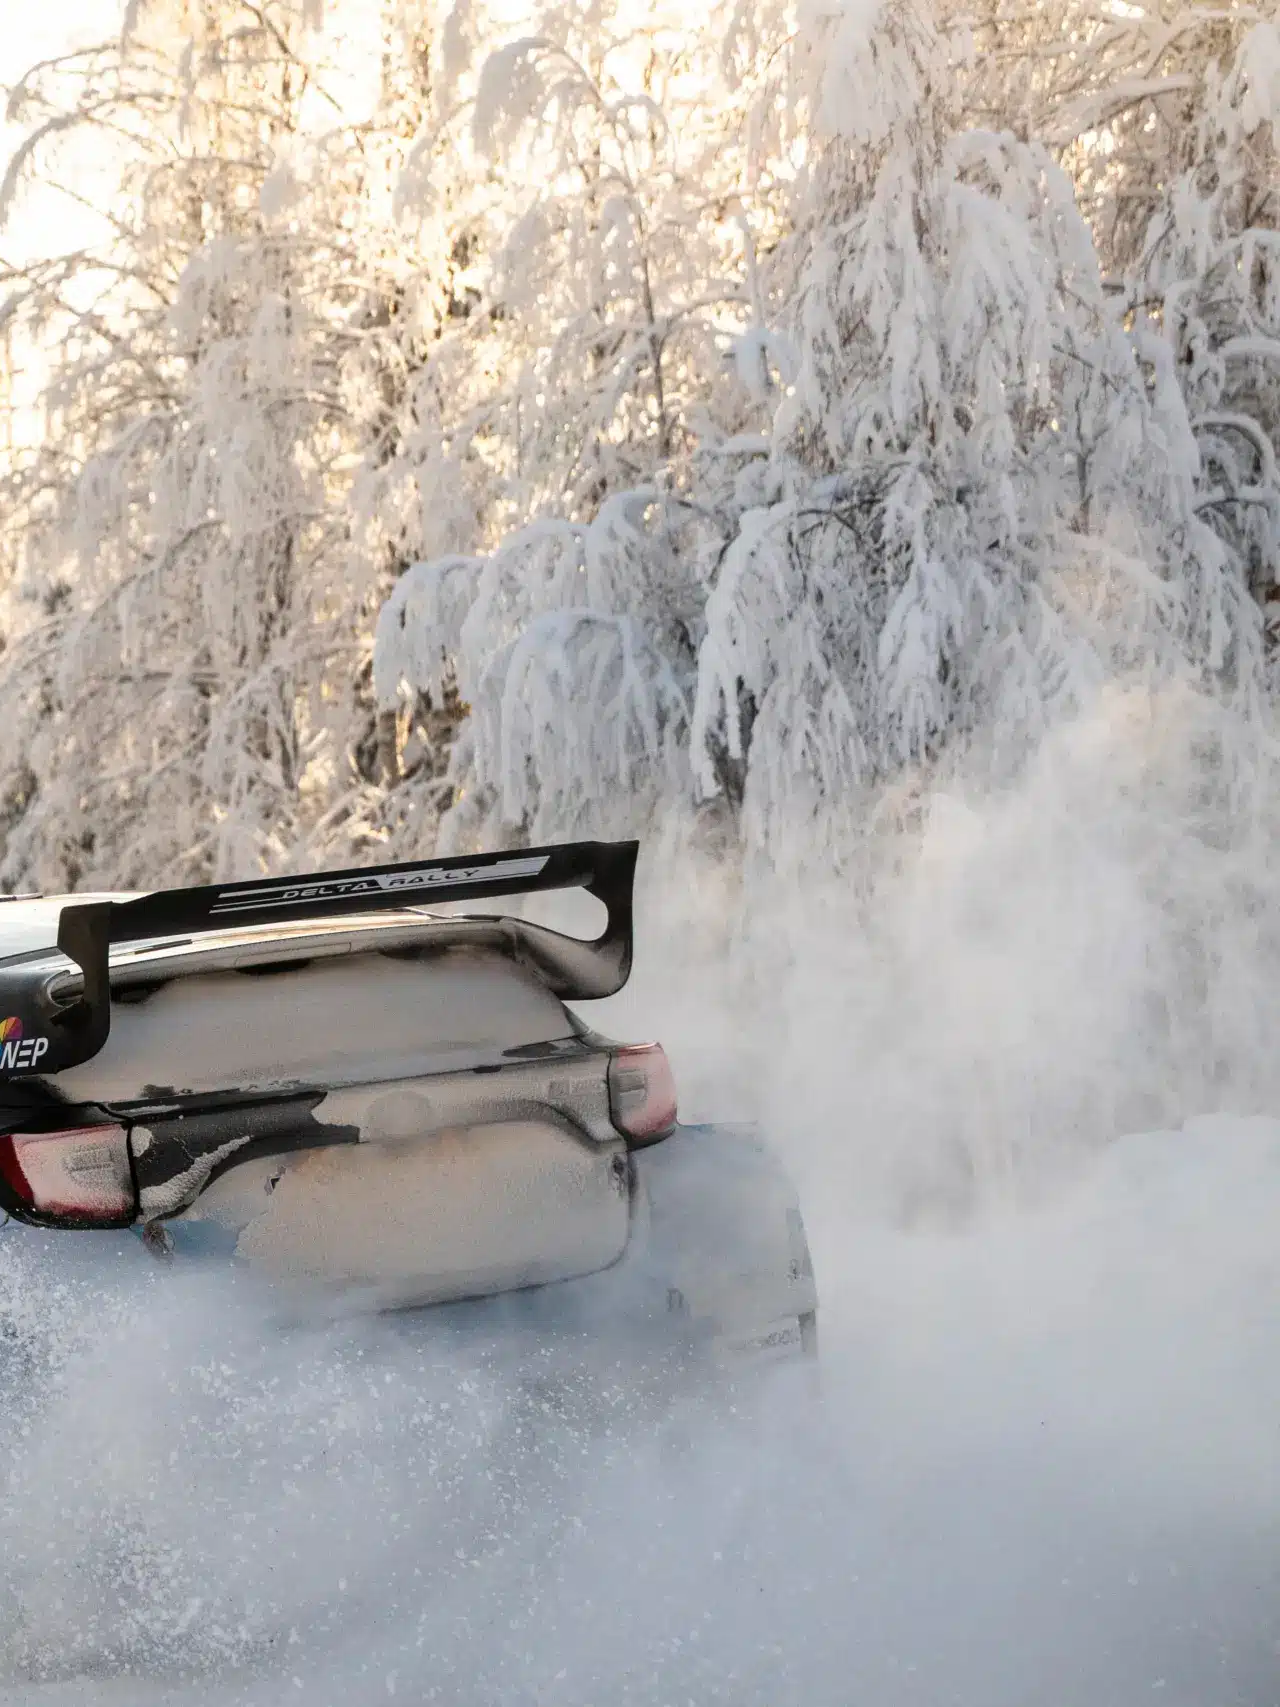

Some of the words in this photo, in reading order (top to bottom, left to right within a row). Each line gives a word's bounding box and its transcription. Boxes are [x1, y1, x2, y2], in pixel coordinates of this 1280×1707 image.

[282, 882, 370, 899] DELTA
[388, 869, 479, 885] RALLY
[0, 1037, 49, 1070] NEP
